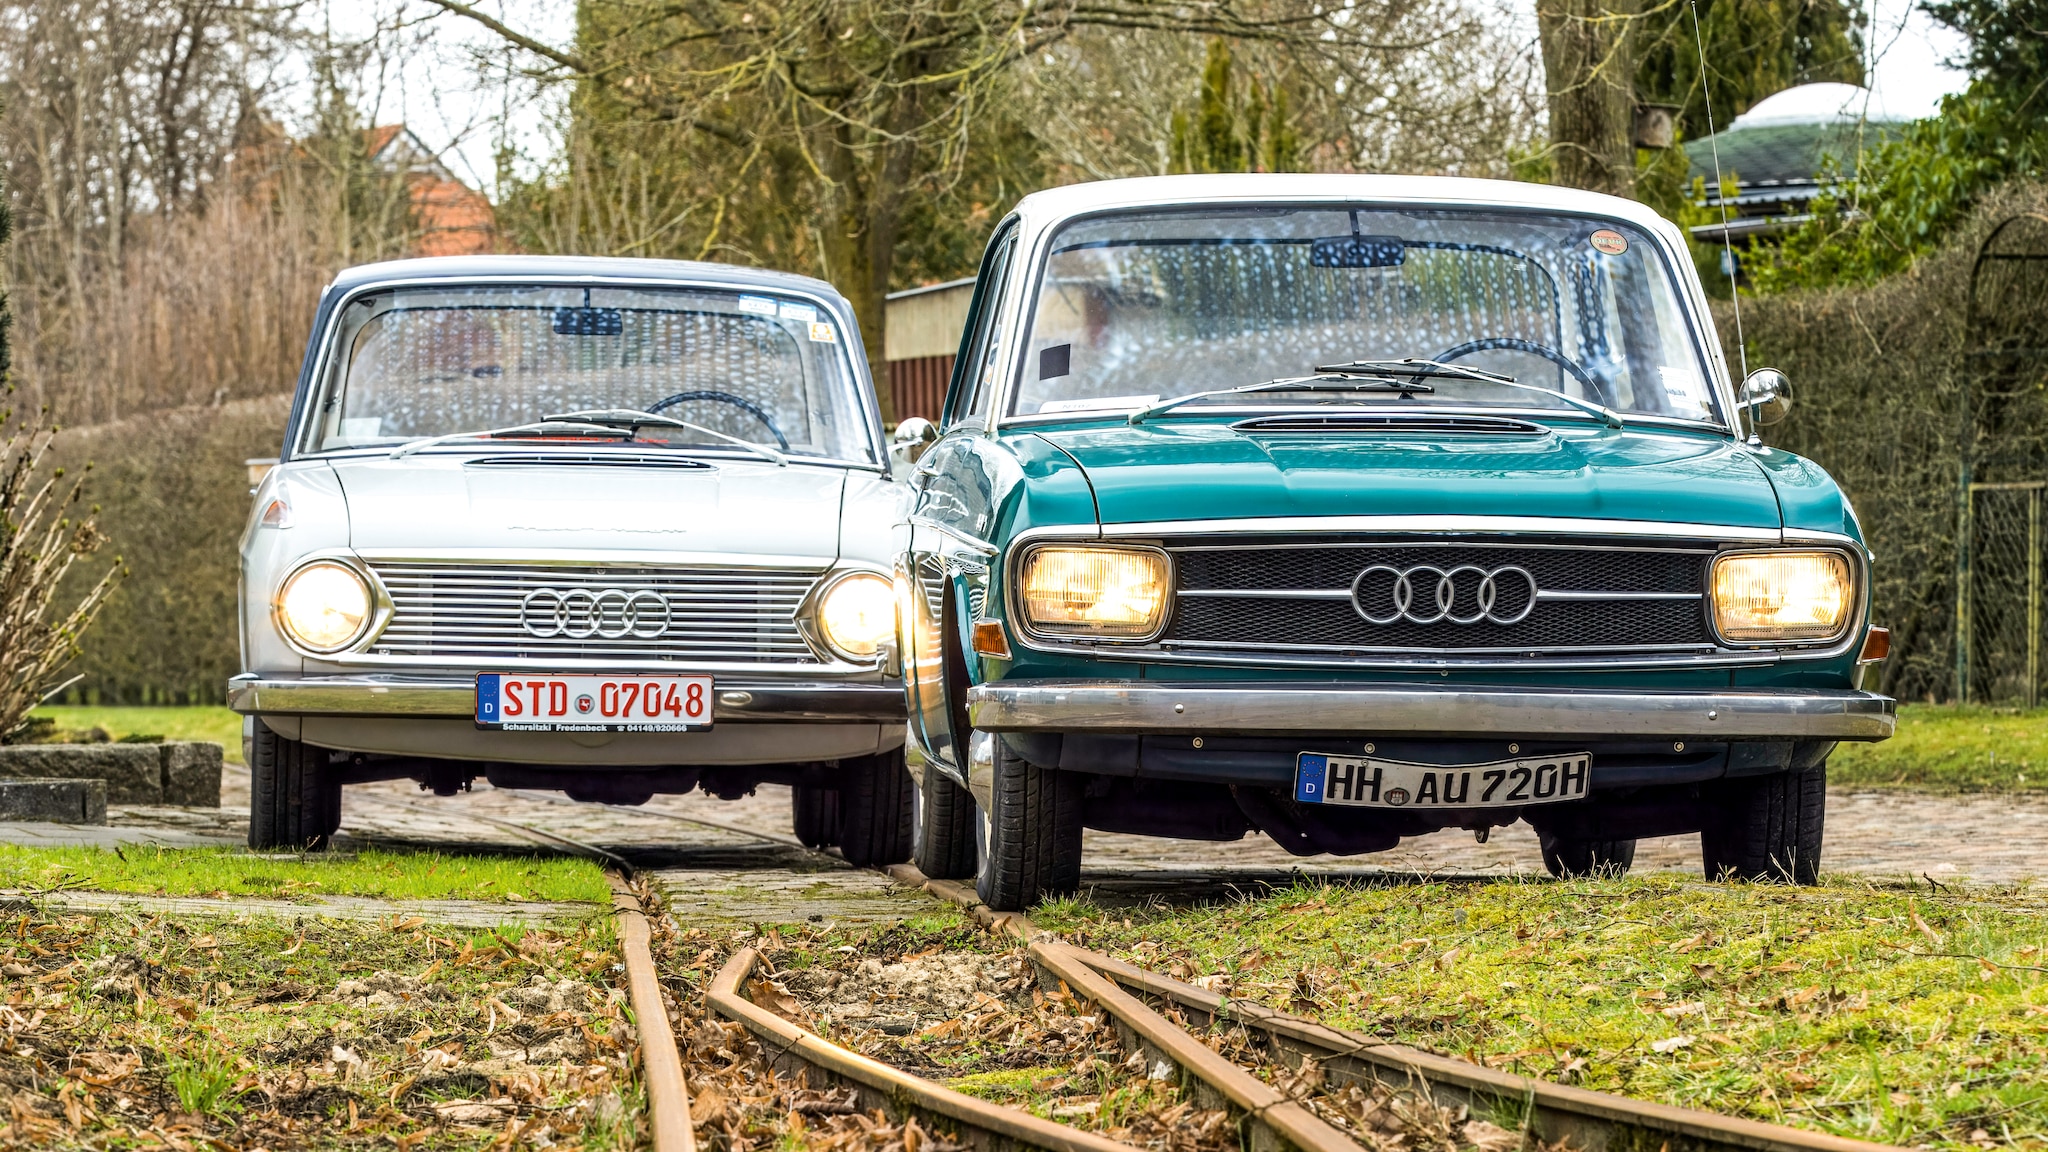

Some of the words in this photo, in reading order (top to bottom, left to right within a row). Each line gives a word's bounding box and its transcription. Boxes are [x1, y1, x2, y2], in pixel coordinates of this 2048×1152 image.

[504, 681, 567, 717] STD
[600, 682, 704, 717] 07048
[484, 702, 493, 713] D
[502, 723, 551, 731] Scharsitzki
[556, 724, 607, 732] Fredenbeck
[627, 724, 687, 732] 04149/920666
[1326, 762, 1383, 801] HH
[1415, 772, 1470, 804] AU
[1481, 760, 1587, 803] 720H
[1305, 783, 1316, 794] D
